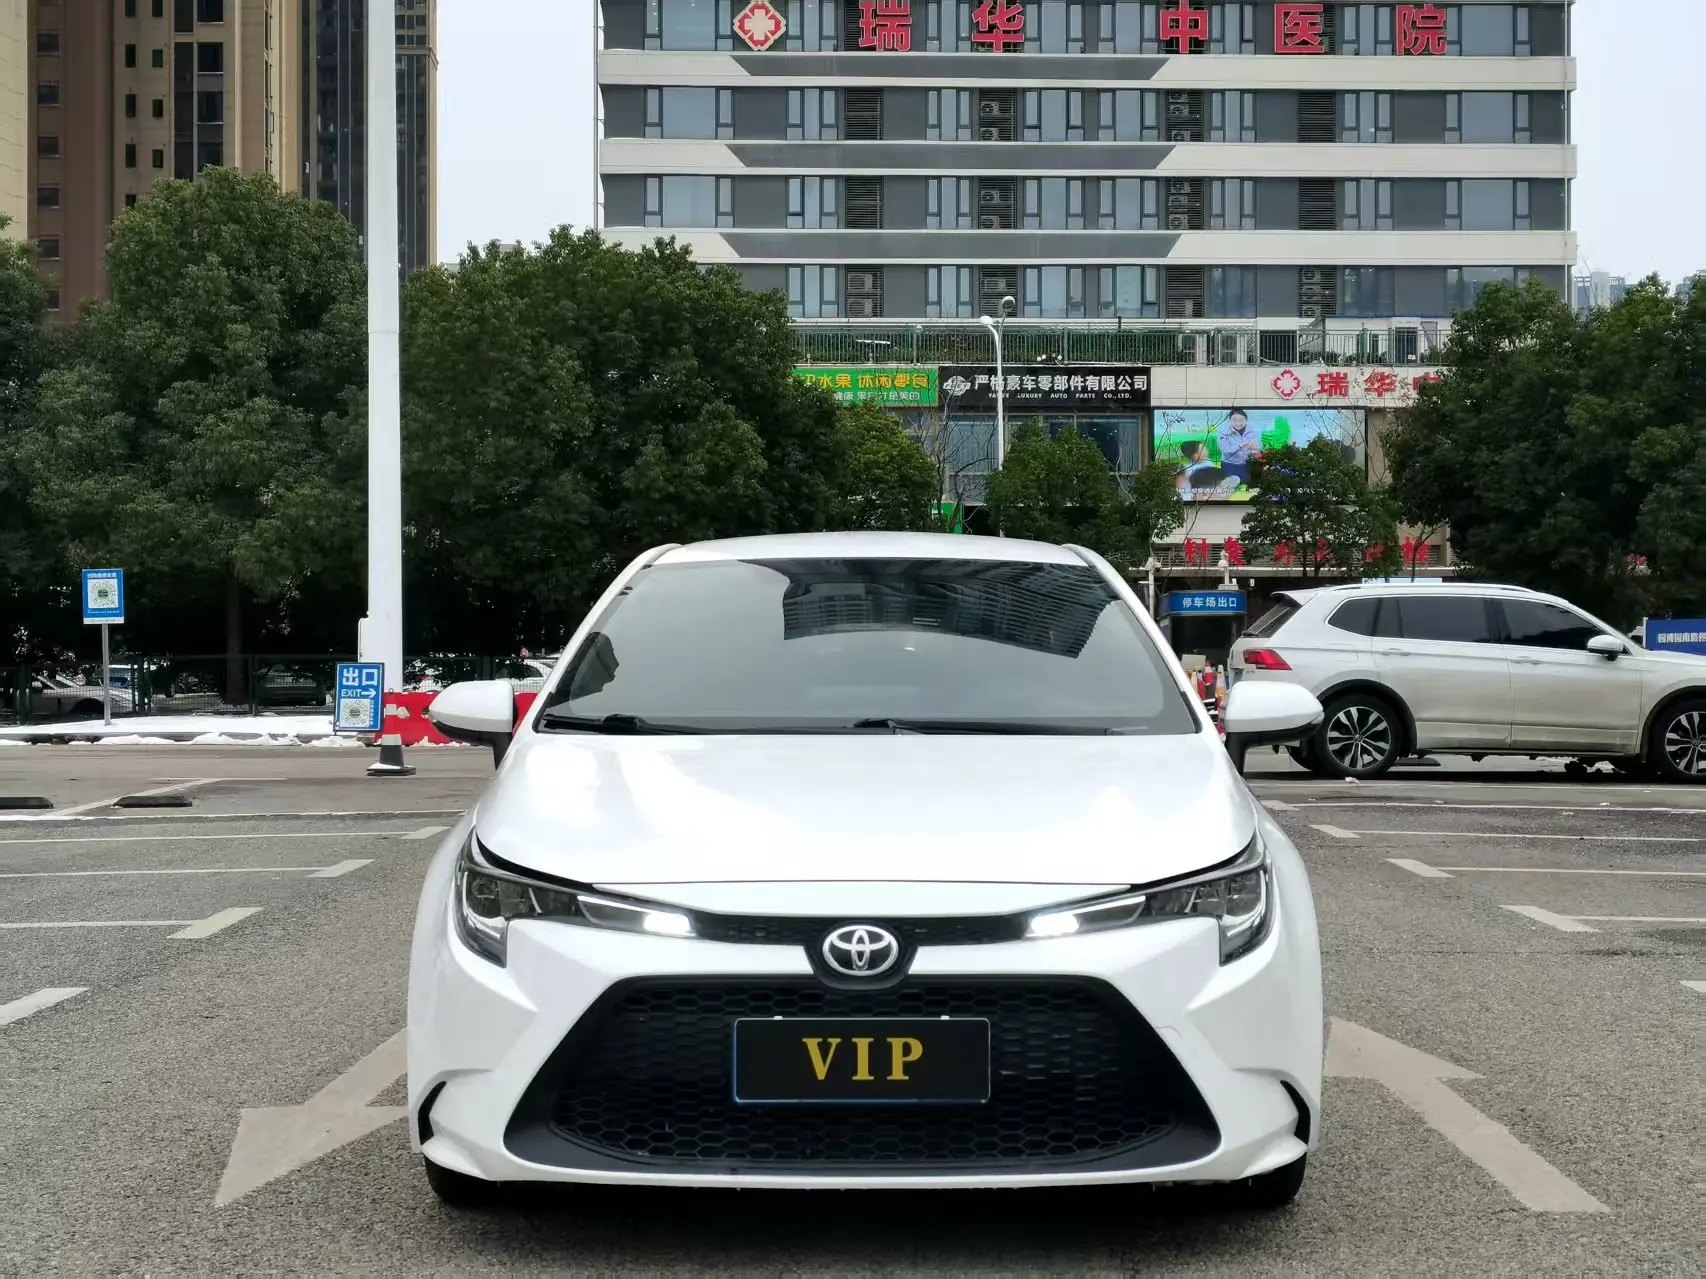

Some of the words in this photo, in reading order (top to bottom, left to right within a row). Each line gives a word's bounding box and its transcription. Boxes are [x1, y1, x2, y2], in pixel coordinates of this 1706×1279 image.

[858, 0, 1447, 56] 瑞华中医院
[858, 373, 929, 389] 休闲零食
[974, 374, 1148, 391] 严格豪车零部件有限公司
[1183, 597, 1237, 608] 停车场出口
[342, 667, 378, 686] 出口
[341, 689, 362, 697] EXIT
[802, 1037, 923, 1081] VIP
